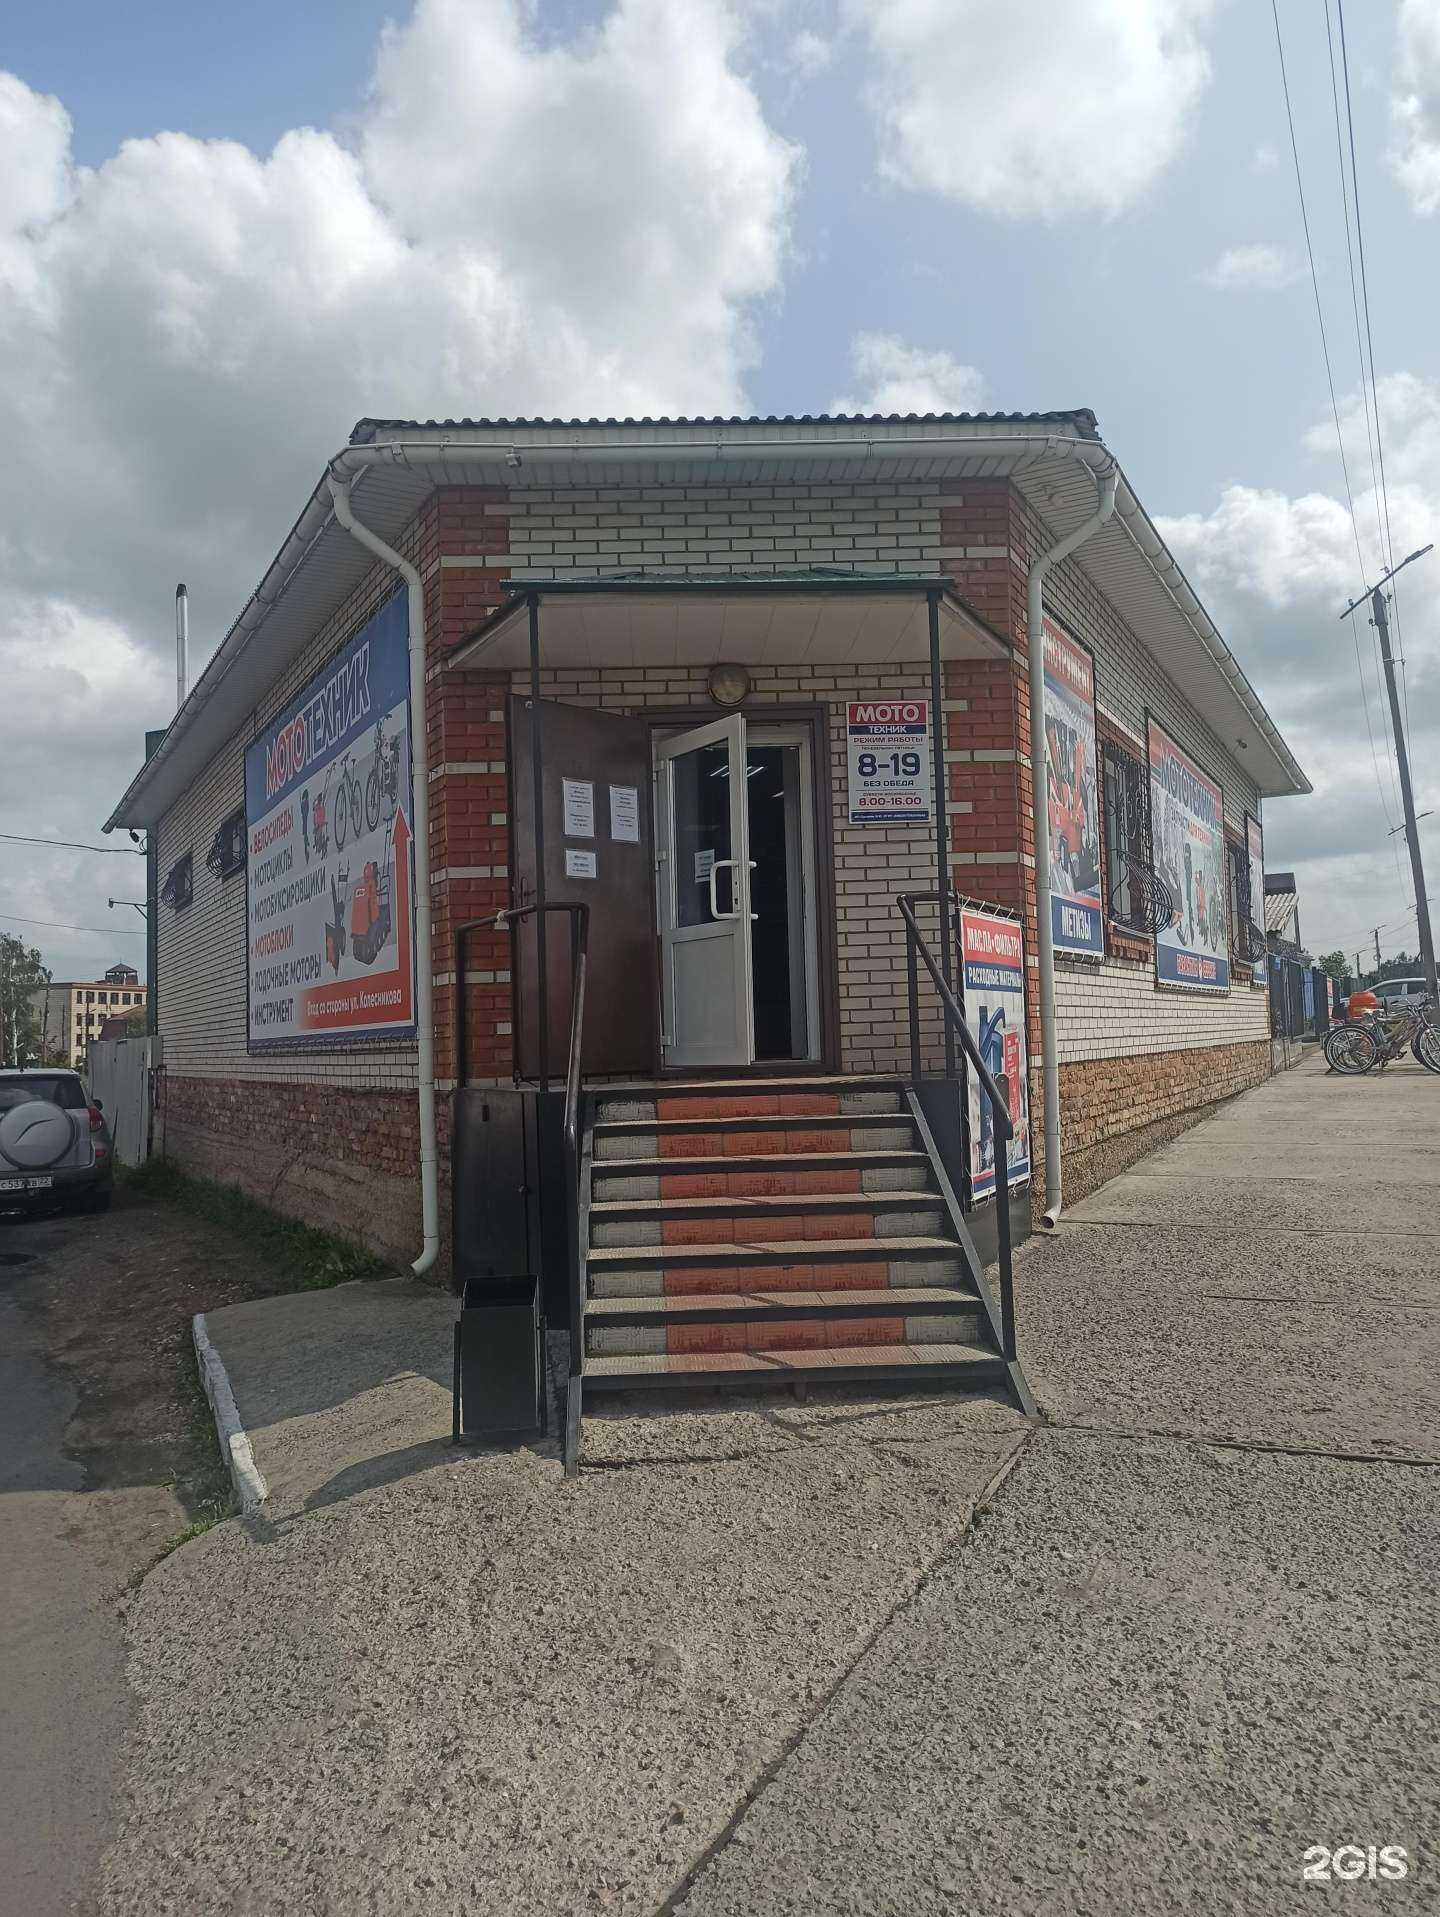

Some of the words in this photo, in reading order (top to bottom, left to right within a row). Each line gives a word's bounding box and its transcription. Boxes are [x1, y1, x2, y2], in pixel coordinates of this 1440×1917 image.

[266, 641, 371, 800] МОТОТЕХНИК
[856, 705, 920, 722] МОТО
[869, 726, 907, 734] ТЕХНИК
[858, 752, 921, 777] 8-19
[253, 805, 294, 855] ВЕЛОСИПЕДЫ
[254, 843, 293, 889] МОТОЦИКЛЫ
[1061, 905, 1092, 940] МЕТИЗЫ
[255, 924, 294, 958] МОТОБЛОКИ
[255, 962, 289, 995] ЛОДОЧНЫЕ
[290, 952, 321, 984] МОТОРЫ
[255, 998, 294, 1026] ИНСТРУМЕНТ
